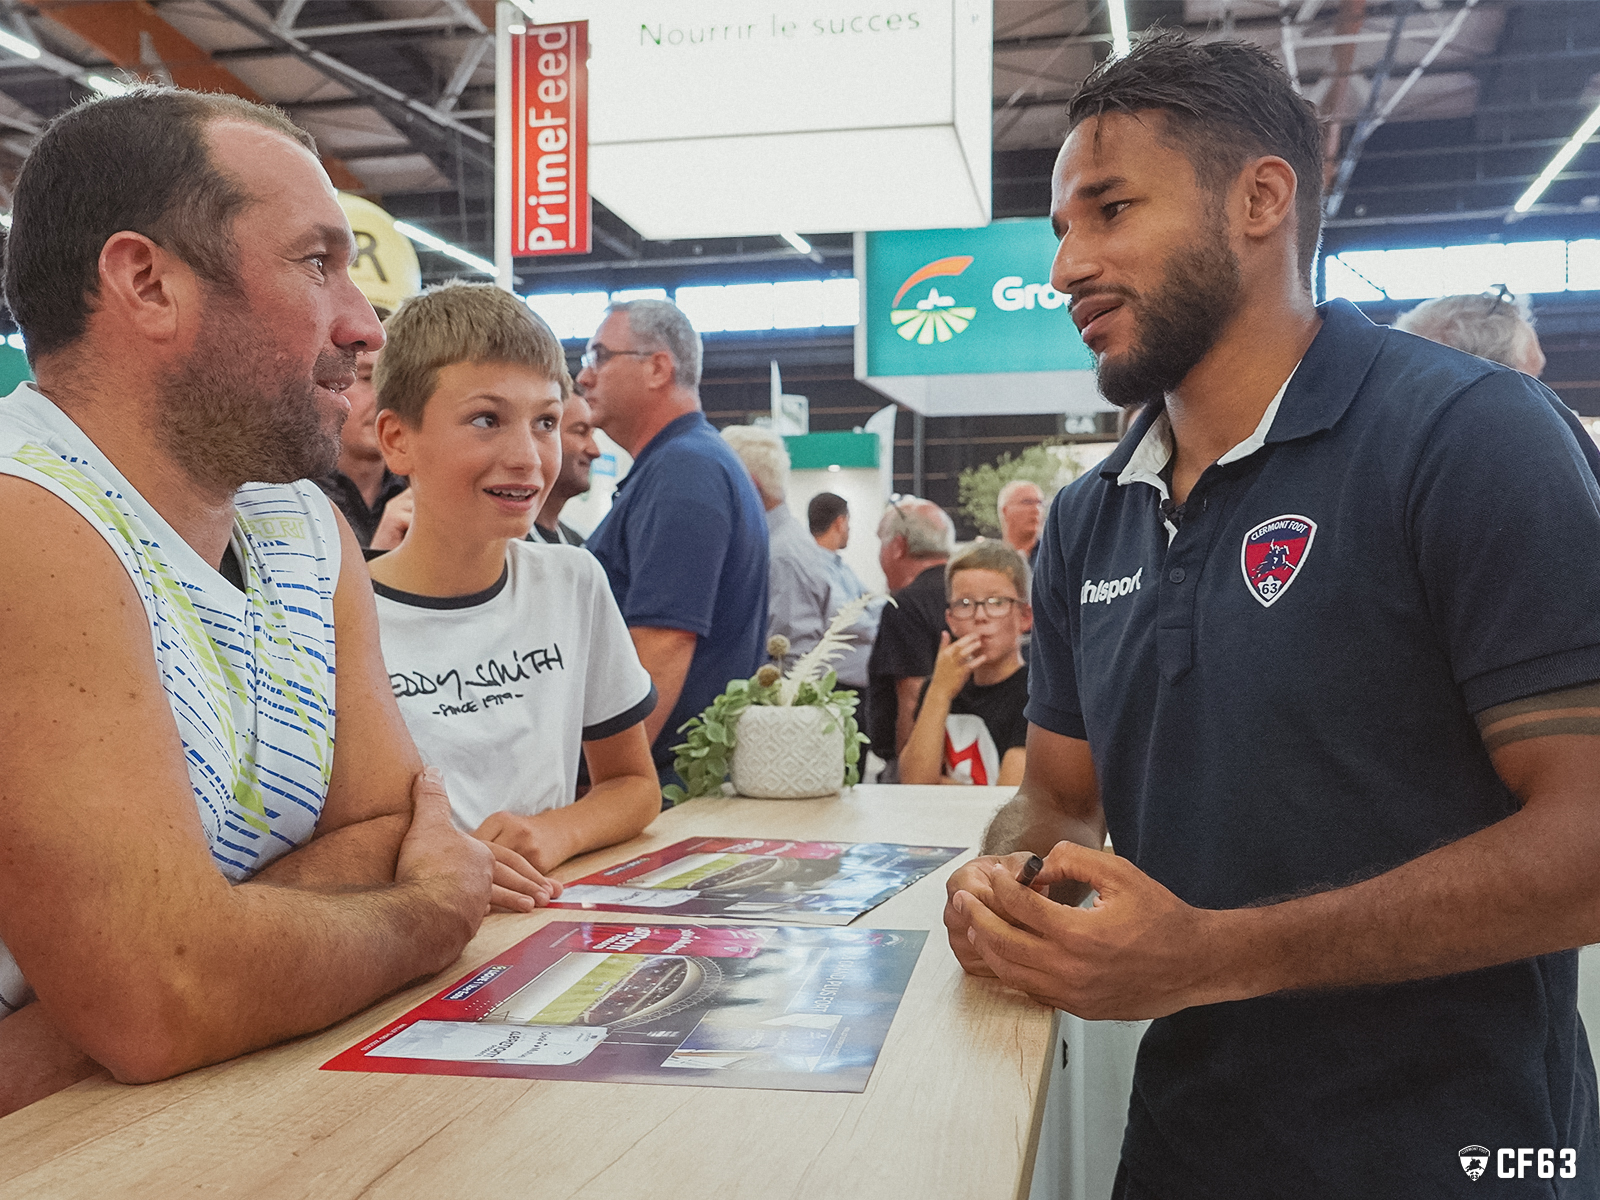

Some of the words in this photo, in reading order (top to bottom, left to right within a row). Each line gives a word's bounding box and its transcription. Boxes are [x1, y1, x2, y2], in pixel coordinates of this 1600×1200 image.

[640, 23, 757, 47] Nourrir
[772, 13, 797, 38] le
[528, 24, 569, 251] PrimeFeed
[991, 275, 1072, 312] Gro
[1250, 520, 1290, 541] CLERMONT
[1288, 520, 1309, 534] FOOT
[1261, 582, 1278, 595] 63
